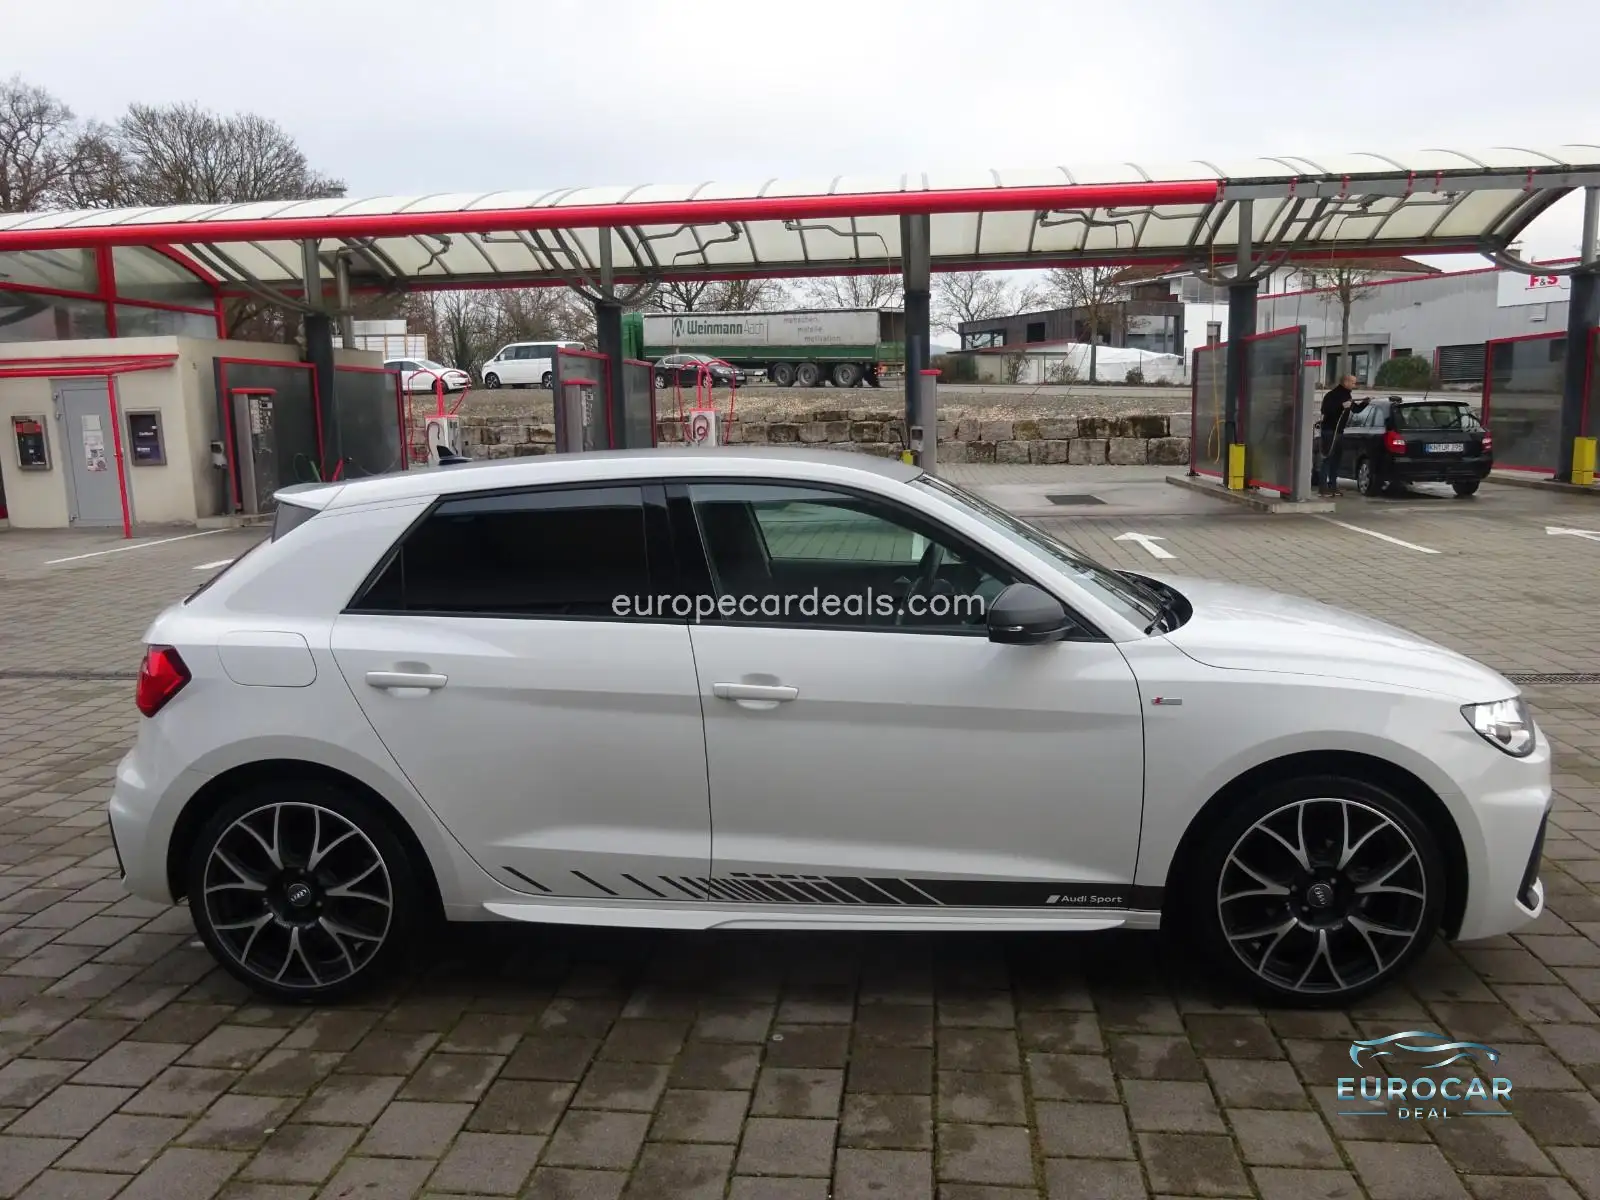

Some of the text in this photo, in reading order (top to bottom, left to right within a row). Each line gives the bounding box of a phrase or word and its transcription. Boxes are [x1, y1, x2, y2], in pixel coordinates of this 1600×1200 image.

[687, 320, 743, 335] Weinmann
[1061, 895, 1123, 904] Audi Sport
